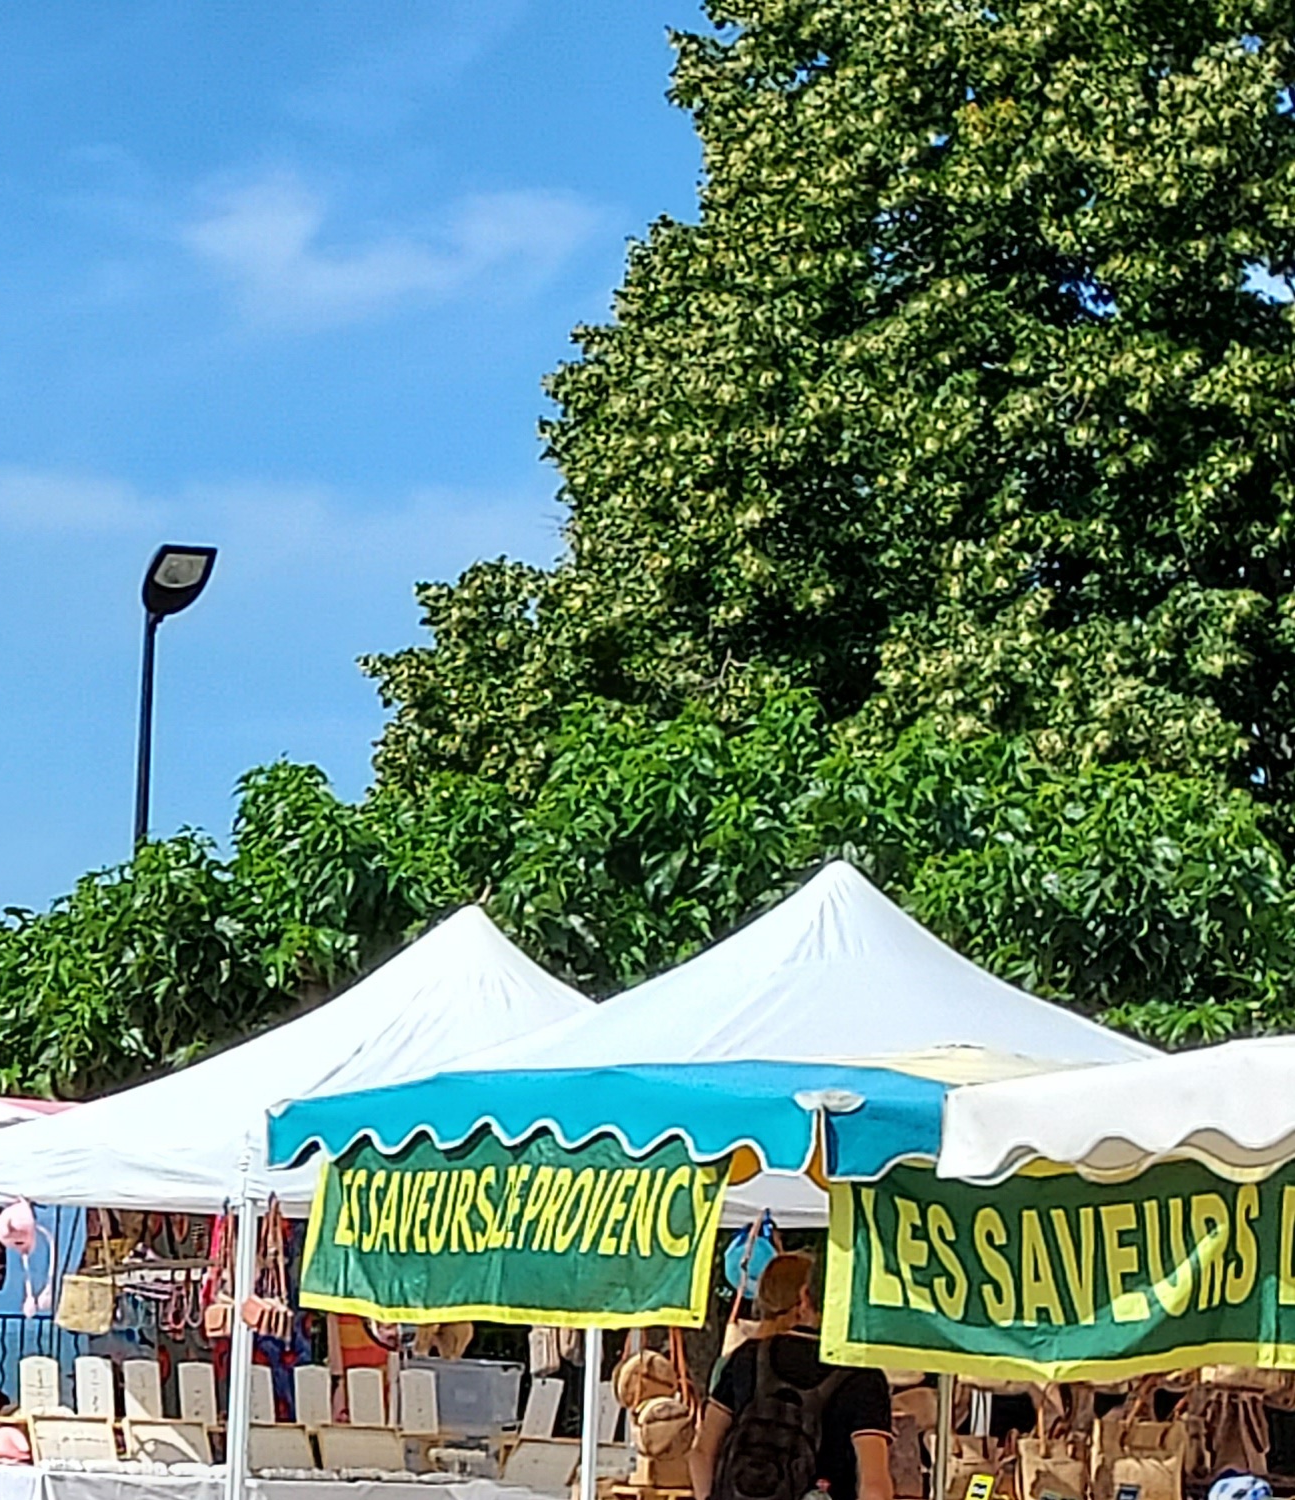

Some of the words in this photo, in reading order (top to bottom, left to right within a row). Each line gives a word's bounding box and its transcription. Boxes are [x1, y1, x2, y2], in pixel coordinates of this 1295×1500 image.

[362, 1166, 495, 1254] SAVEURS
[861, 1187, 968, 1321] LES
[974, 1184, 1258, 1326] SAVEURS
